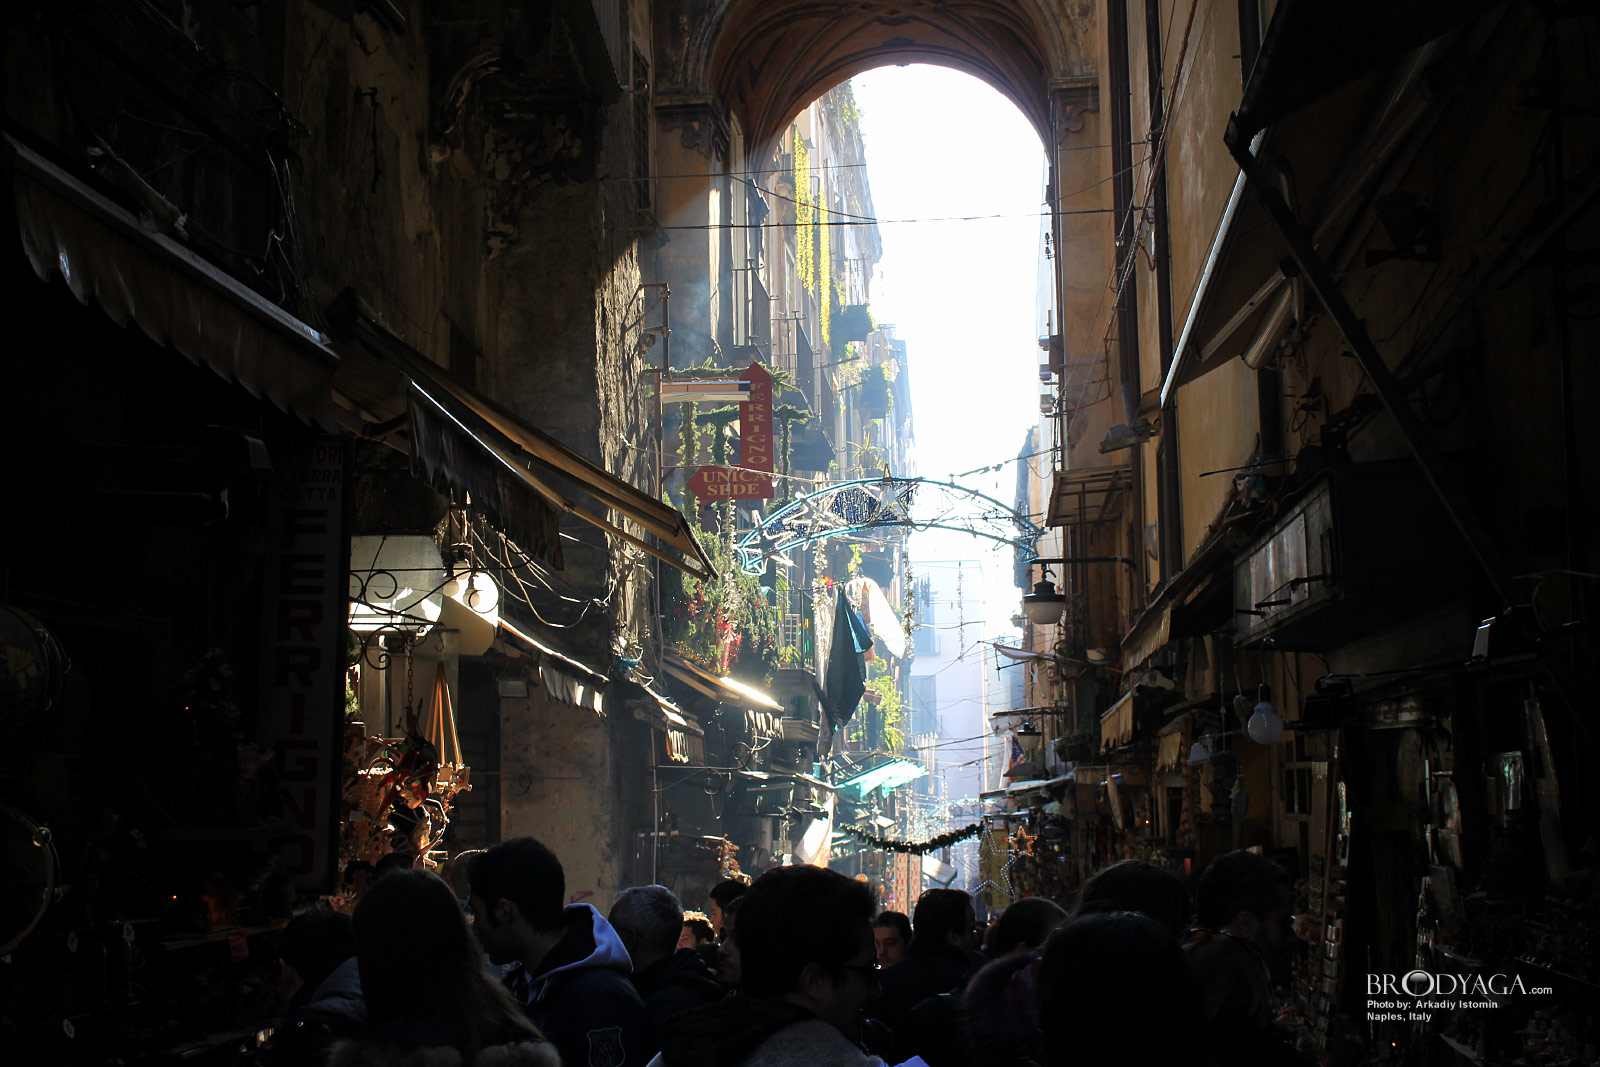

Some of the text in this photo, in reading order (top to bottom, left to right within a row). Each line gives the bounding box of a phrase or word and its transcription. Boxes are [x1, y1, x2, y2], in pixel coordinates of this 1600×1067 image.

[746, 382, 768, 464] FERRIGNO
[703, 471, 767, 482] UNICA
[707, 483, 760, 496] SEDE
[272, 508, 329, 877] FERRIGNO
